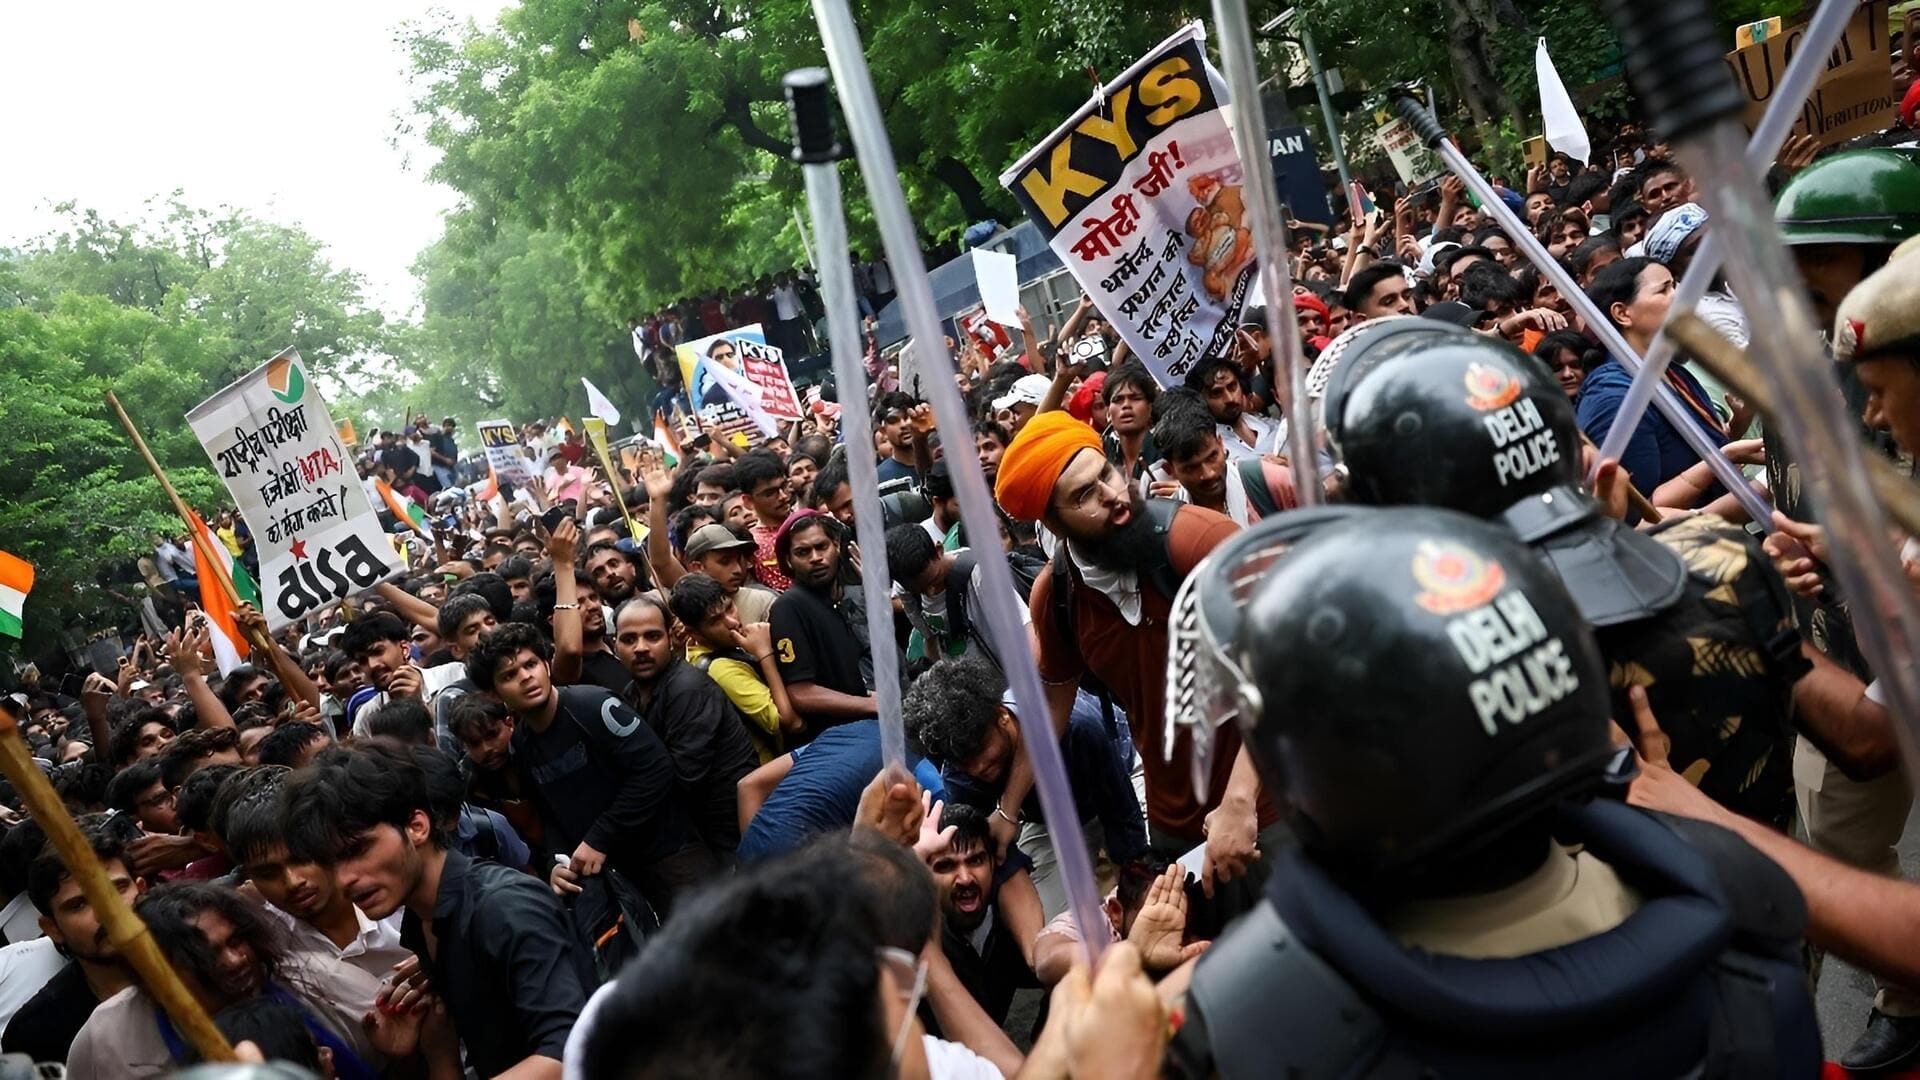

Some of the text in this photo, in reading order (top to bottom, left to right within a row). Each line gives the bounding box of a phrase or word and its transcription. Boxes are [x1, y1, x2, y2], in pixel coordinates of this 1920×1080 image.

[1021, 57, 1201, 228] KYS
[1268, 135, 1304, 157] AN
[1070, 141, 1185, 261] मोदी जी!
[1117, 229, 1184, 320] प्रधान को
[1136, 267, 1187, 339] तत्काल
[1482, 397, 1544, 448] DELHI
[1493, 429, 1560, 486] POLICE
[277, 534, 391, 620] aisa
[777, 637, 796, 663] 3
[1446, 590, 1547, 673] DELHI
[1469, 638, 1579, 736] POLICE
